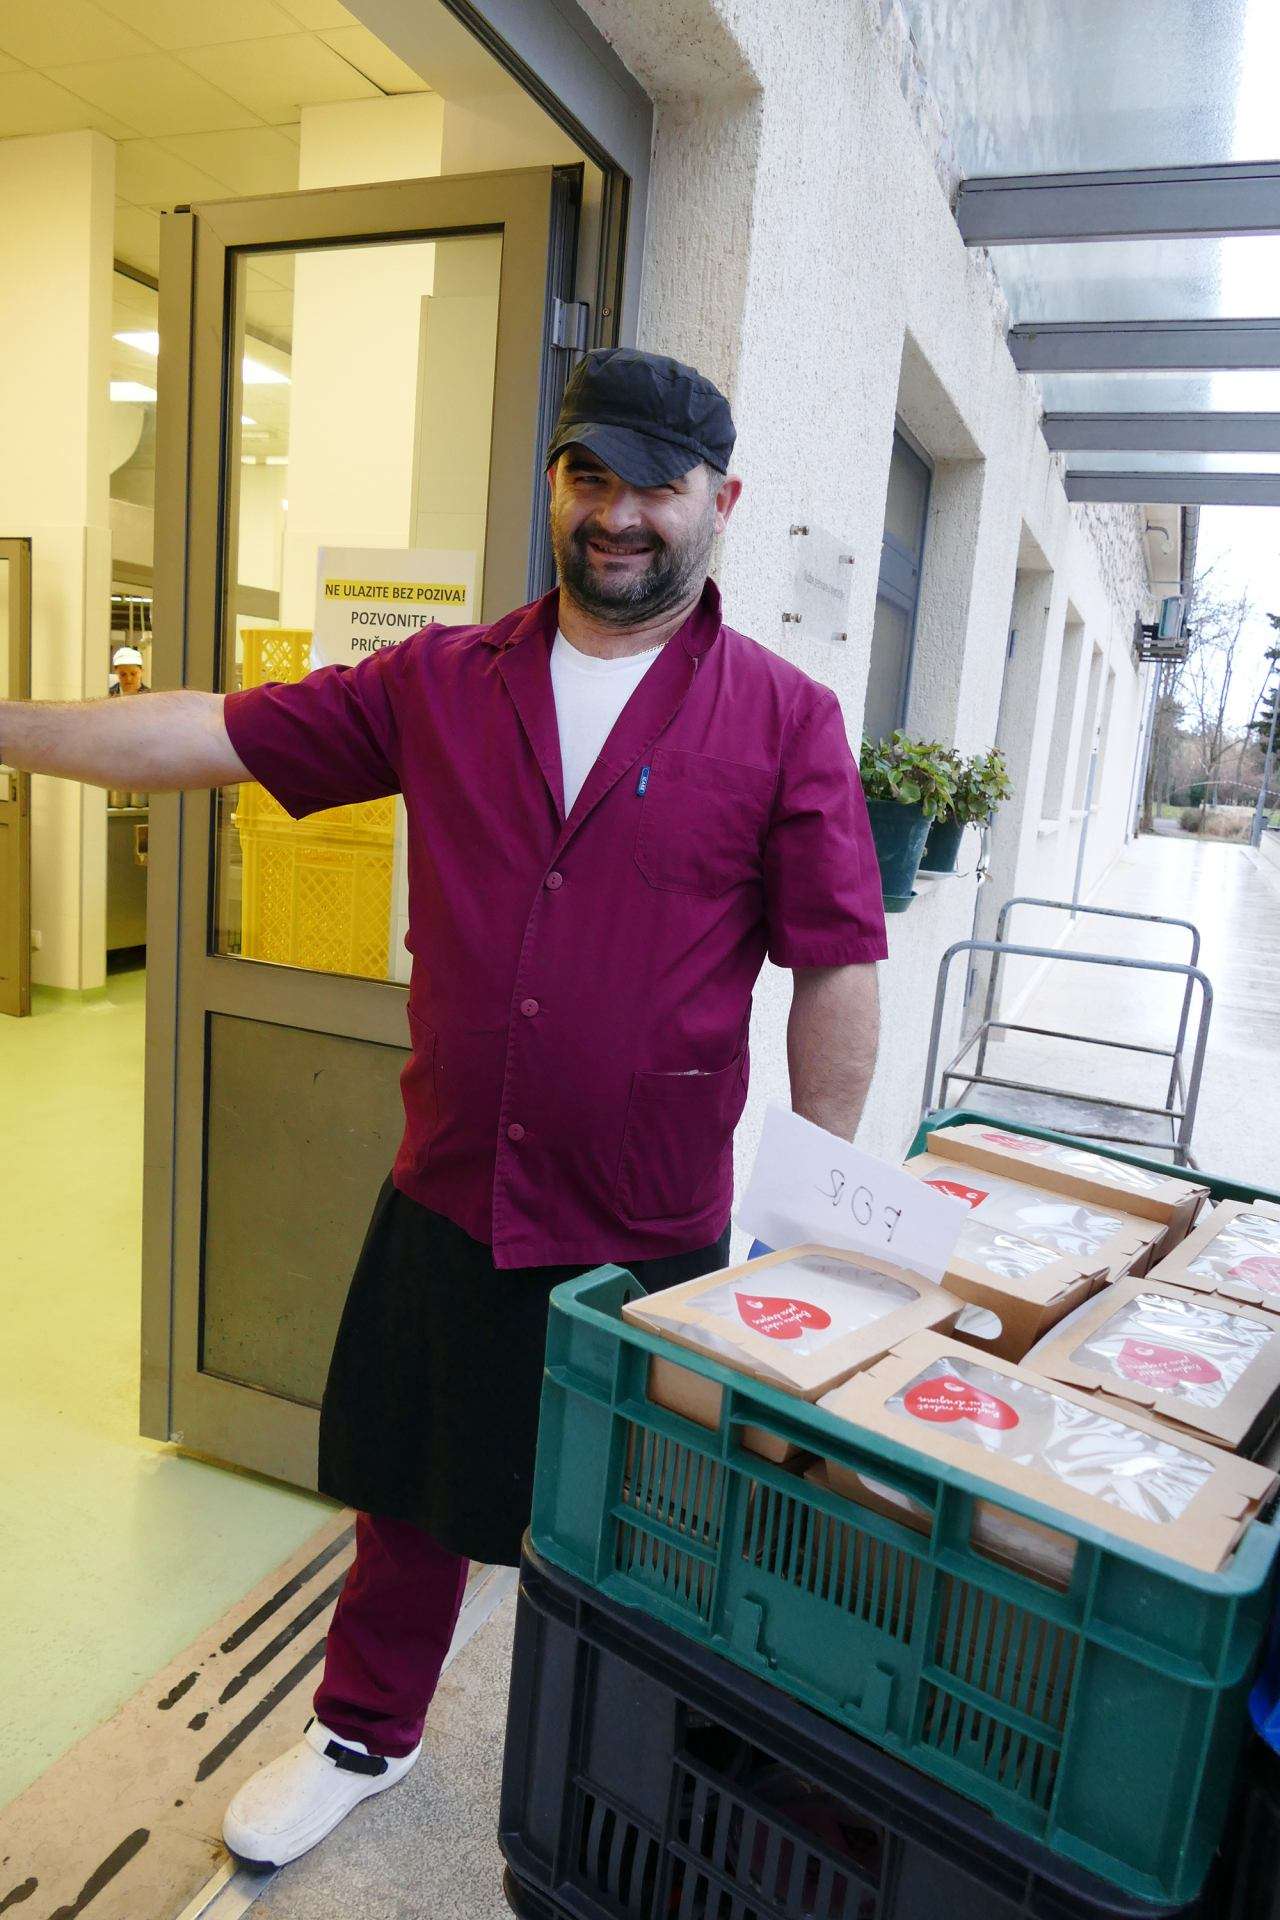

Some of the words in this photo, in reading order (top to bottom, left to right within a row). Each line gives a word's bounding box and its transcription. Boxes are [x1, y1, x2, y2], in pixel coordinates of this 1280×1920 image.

[325, 584, 340, 596] NE
[343, 584, 389, 598] ULAZITE
[392, 587, 414, 599] BEZ
[416, 588, 466, 602] POZIVA!
[351, 611, 427, 628] POZVONITE
